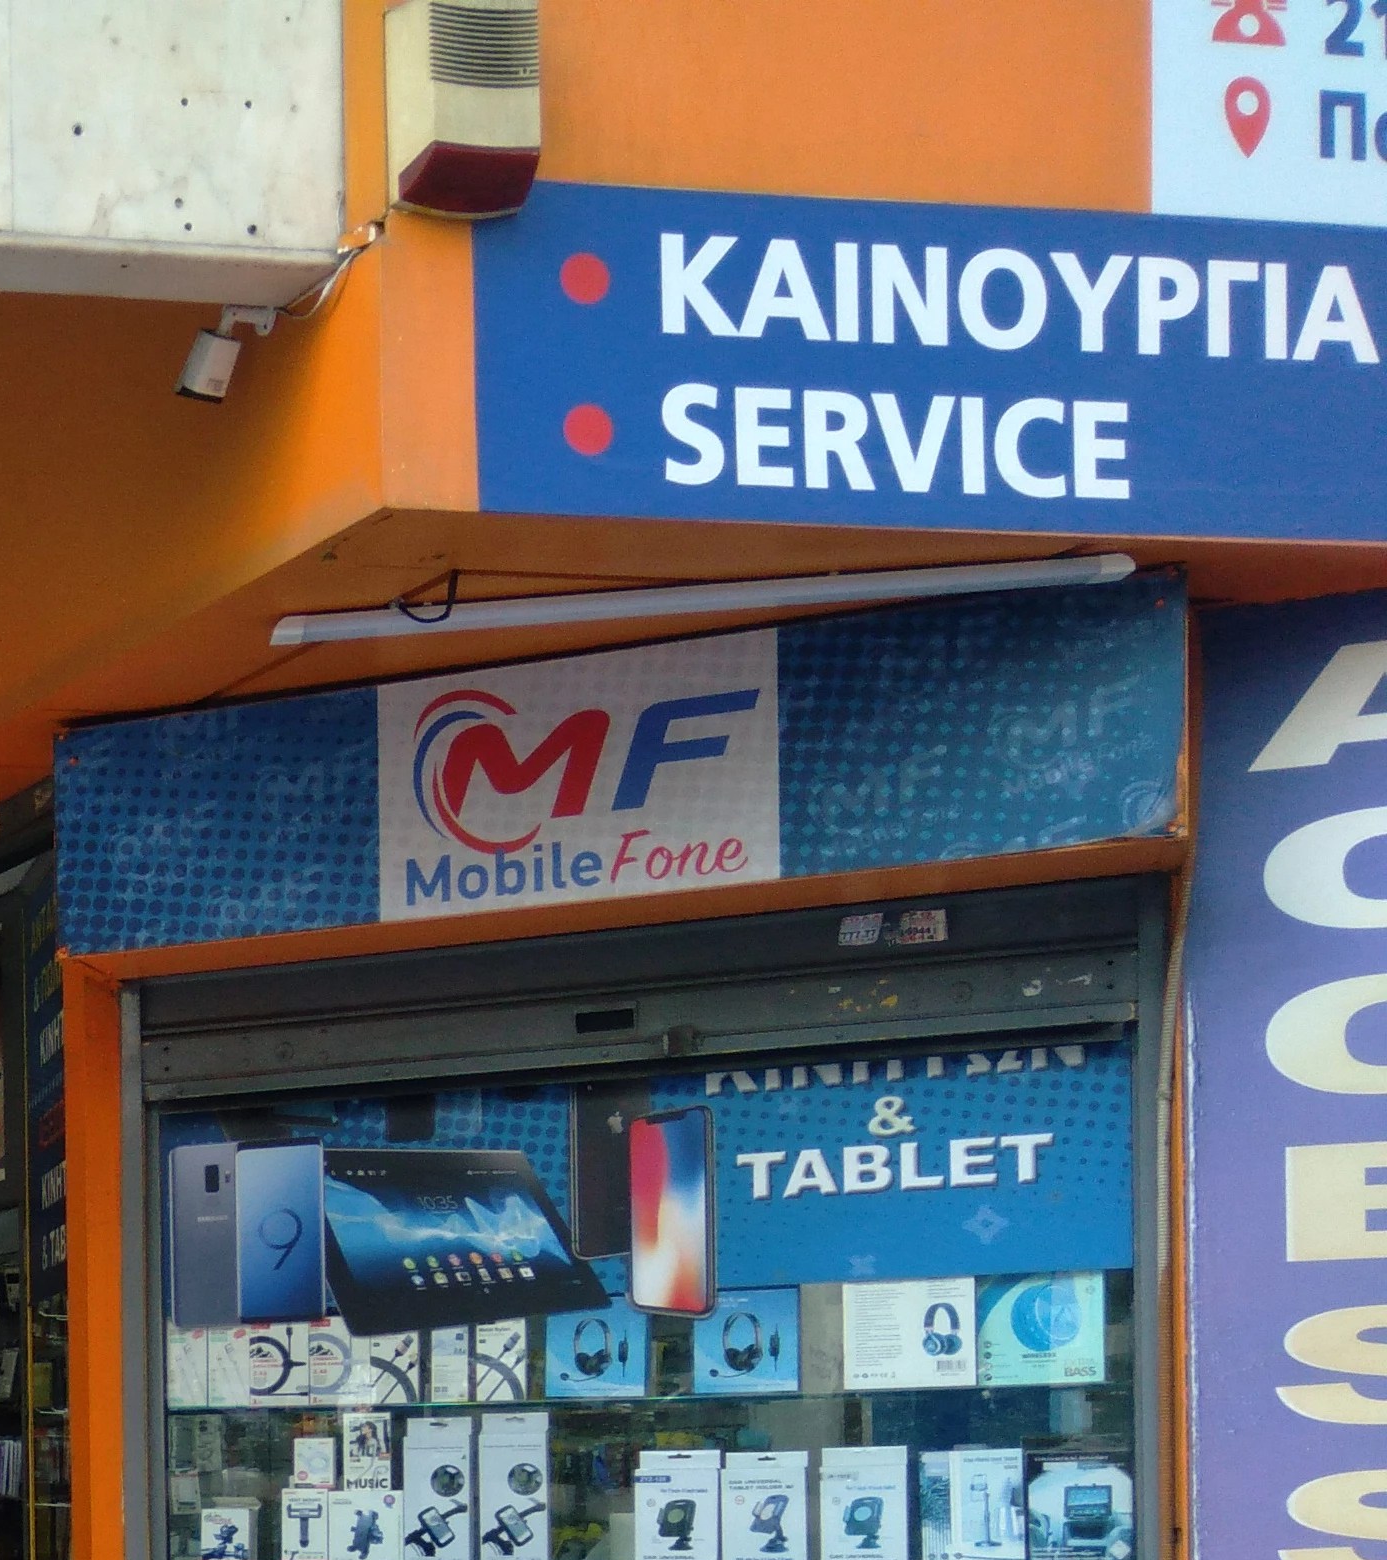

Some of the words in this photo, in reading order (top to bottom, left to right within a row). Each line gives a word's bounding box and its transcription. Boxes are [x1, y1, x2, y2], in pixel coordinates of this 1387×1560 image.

[660, 232, 1382, 365] ΚΑΙΝΟΥΡΓΙΑ
[661, 382, 1132, 500] SERVICE
[417, 688, 759, 852] MF
[867, 1095, 916, 1137] &
[735, 1132, 1055, 1201] TABLET
[1064, 1366, 1097, 1377] BASS
[346, 1478, 389, 1489] MUSIC
